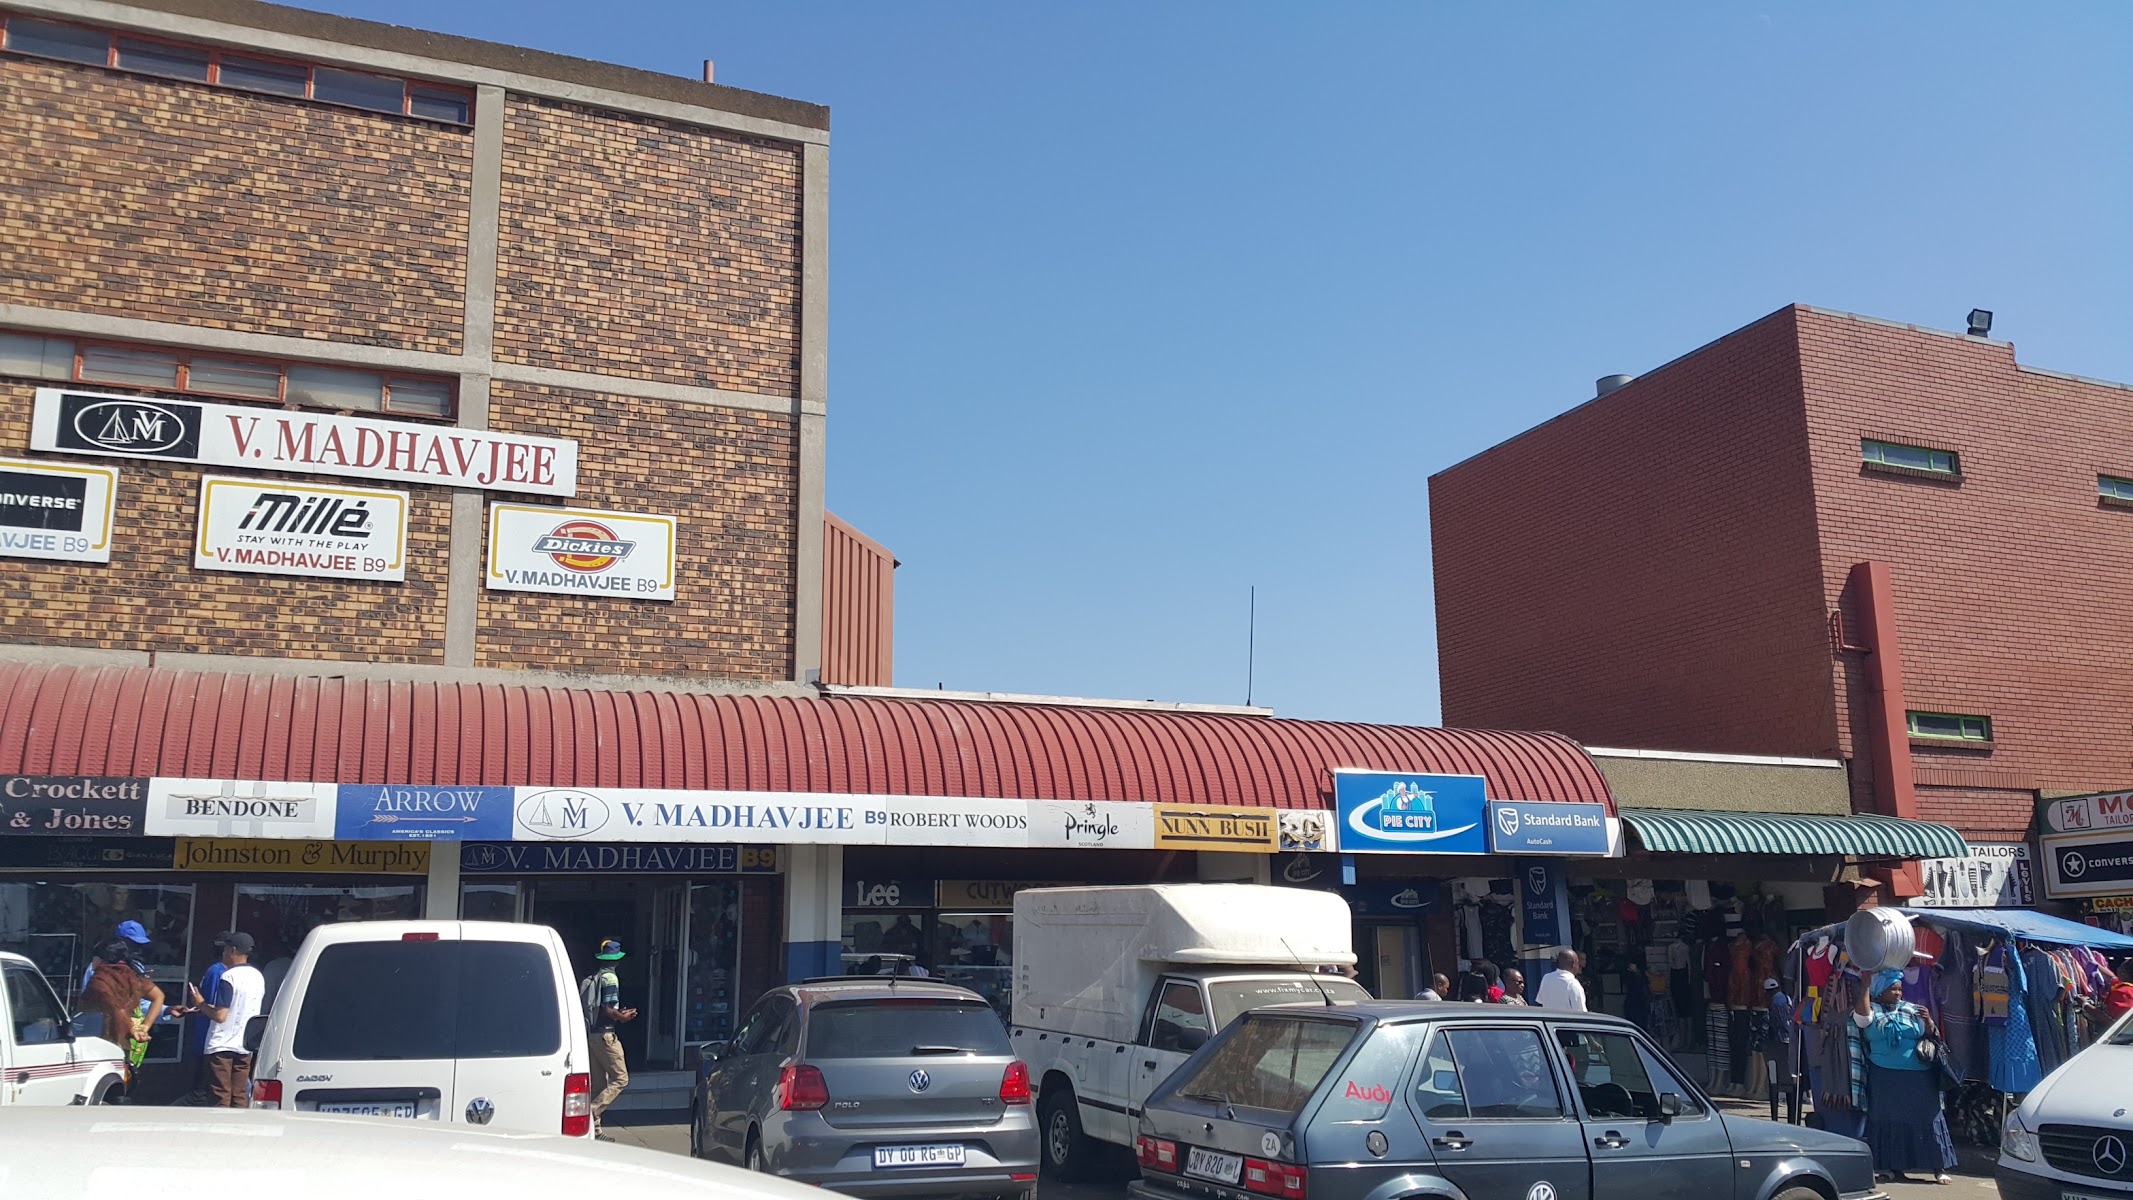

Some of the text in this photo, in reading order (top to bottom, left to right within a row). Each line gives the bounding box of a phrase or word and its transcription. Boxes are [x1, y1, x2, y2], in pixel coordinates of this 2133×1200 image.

[226, 414, 556, 486] V. MADHAVJEE
[0, 532, 89, 553] VJEE B9
[237, 535, 369, 551] STAY WITH THE PLAY
[542, 537, 624, 556] Dickies
[363, 557, 386, 573] B9
[637, 579, 658, 593] B9
[5, 777, 141, 801] Crockett
[186, 799, 299, 818] BENDONE
[374, 787, 484, 812] ARROW
[10, 808, 133, 830] & Jones
[621, 802, 887, 830] V. MADHAVJEE B9
[890, 811, 1028, 830] ROBERT WOODS
[1383, 814, 1433, 828] PIE CITY
[1523, 812, 1601, 829] Standard Bank
[1064, 811, 1120, 841] Pringle
[1162, 818, 1269, 837] NUNN BUSH
[1526, 837, 1553, 846] AutoCash
[179, 841, 428, 871] Johnston & Murphy
[508, 846, 736, 871] V. MADHAVJEE
[743, 848, 776, 868] B9
[1972, 847, 2026, 858] TAILORS
[857, 881, 900, 906] Lee
[1526, 900, 1554, 910] Standard
[1532, 911, 1548, 920] Bank
[296, 1074, 333, 1083] CADDY
[1345, 1080, 1391, 1104] Audi
[1265, 1136, 1278, 1152] ZA
[879, 1146, 894, 1163] DY
[921, 1146, 937, 1162] RG
[946, 1146, 963, 1162] GP
[1188, 1151, 1239, 1180] CBY 820 L
